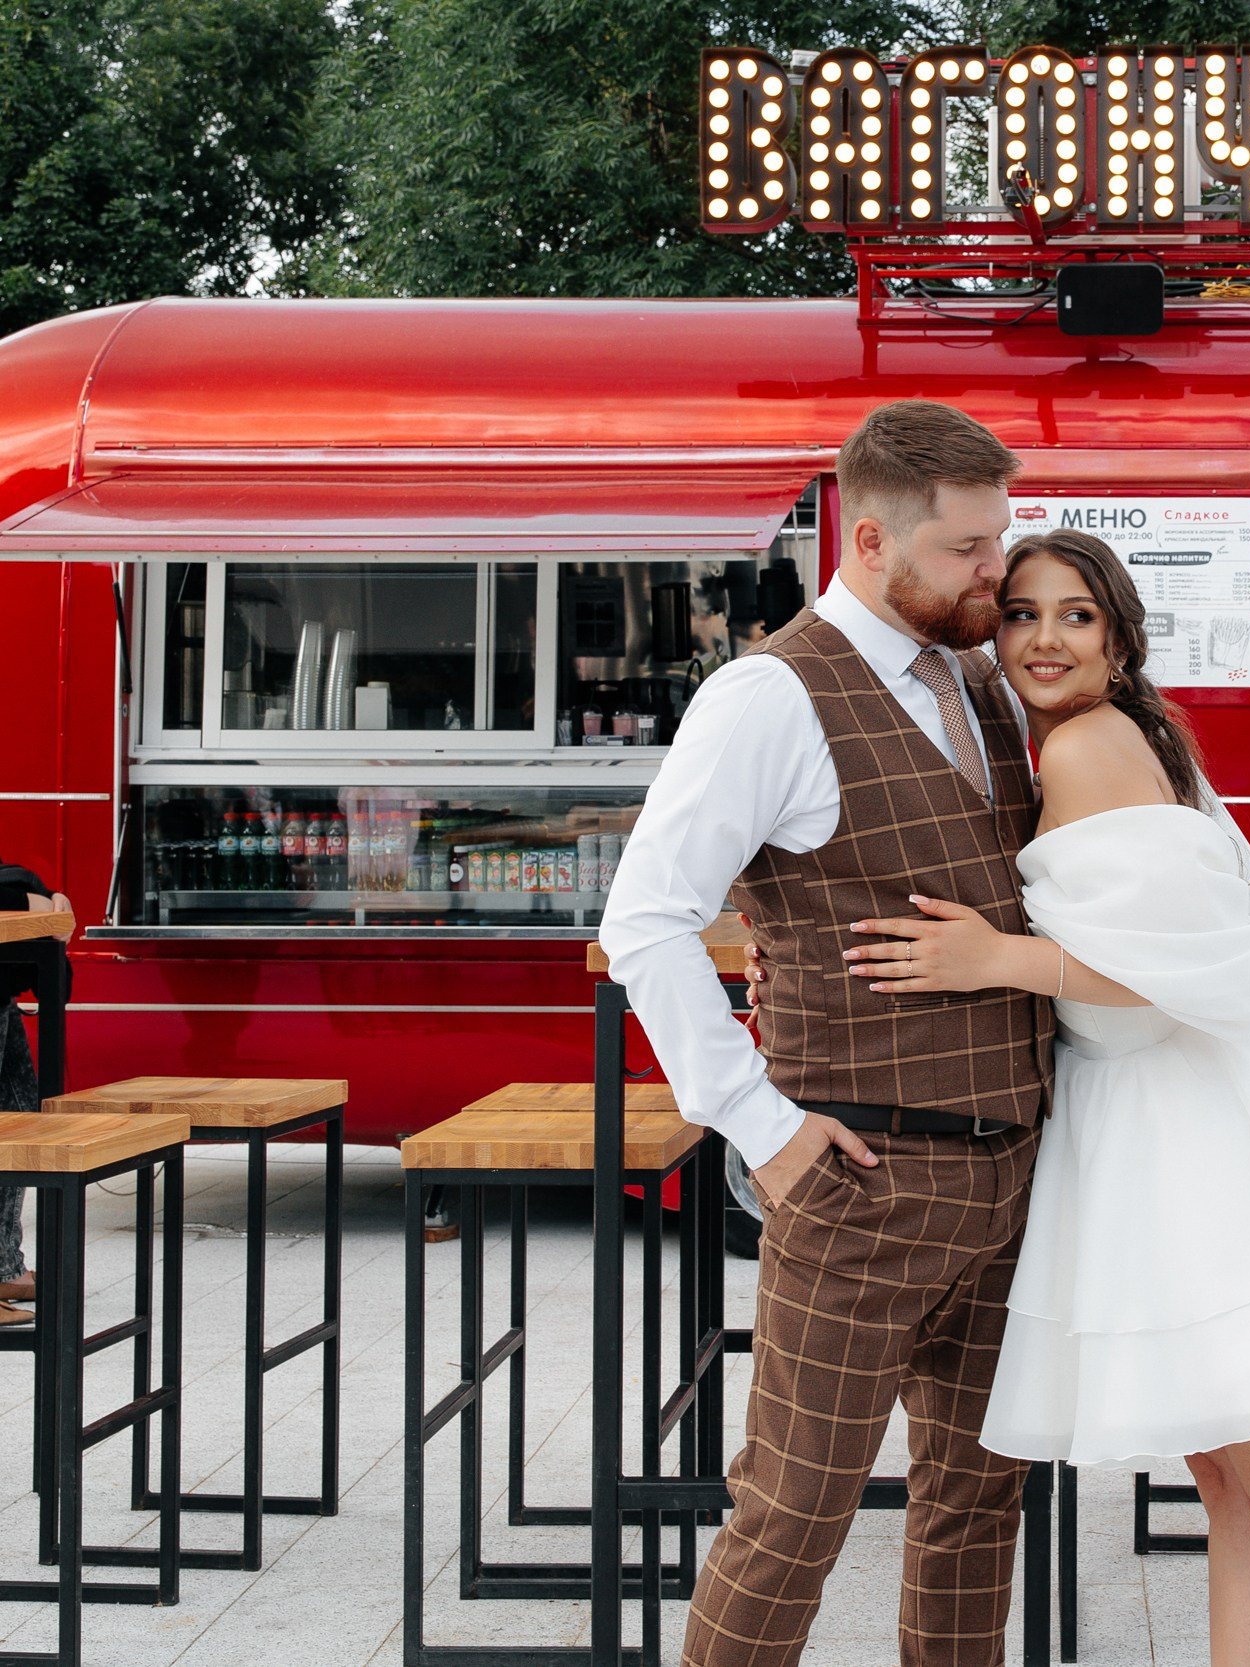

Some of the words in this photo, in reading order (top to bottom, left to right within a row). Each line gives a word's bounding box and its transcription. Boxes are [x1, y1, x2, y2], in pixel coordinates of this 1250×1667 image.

[1061, 508, 1147, 529] МЕНЮ
[1164, 509, 1230, 522] Сладкое
[1114, 532, 1126, 542] до
[1128, 531, 1153, 540] 22:00
[1132, 553, 1170, 563] Горячие
